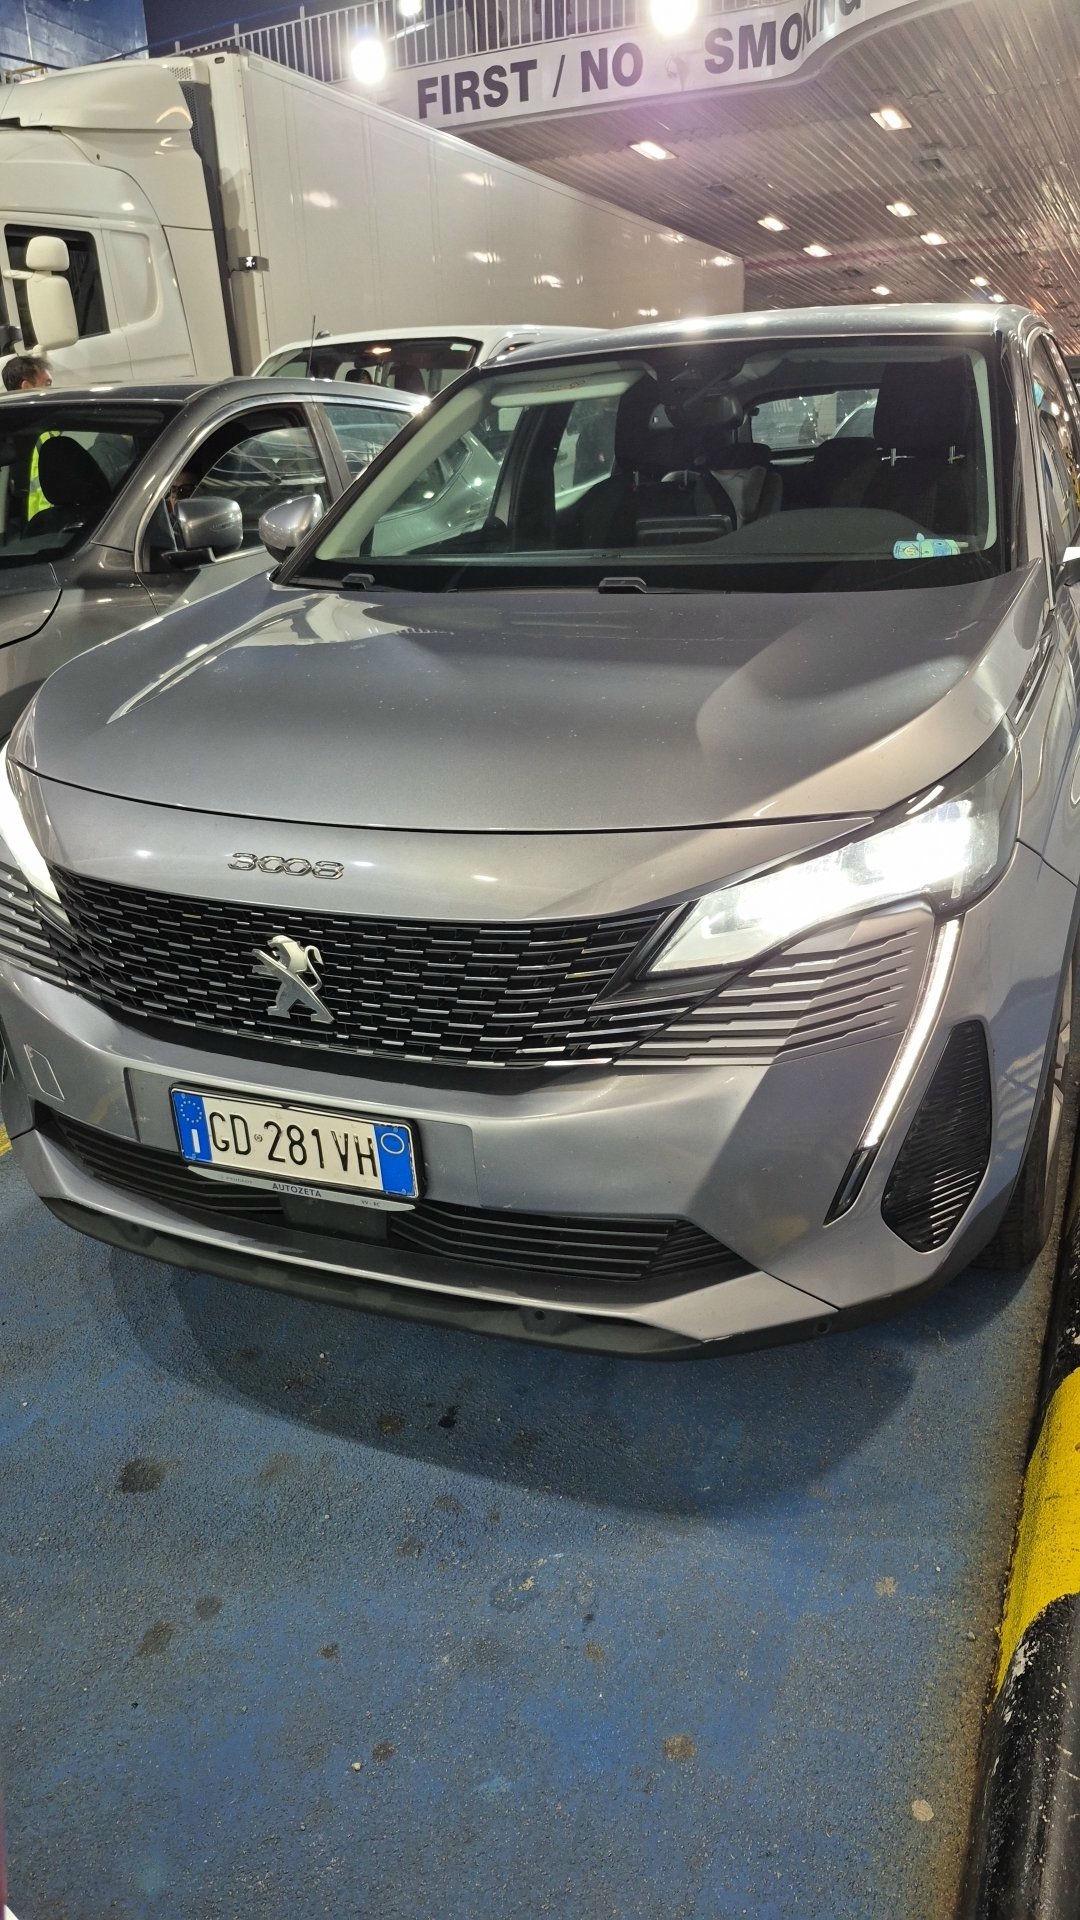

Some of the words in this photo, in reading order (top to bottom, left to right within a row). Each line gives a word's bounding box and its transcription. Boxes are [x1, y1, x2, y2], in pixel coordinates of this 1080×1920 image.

[417, 59, 538, 119] FIRST
[552, 54, 566, 98] /
[580, 42, 644, 93] NO
[227, 852, 345, 880] 3008
[209, 1111, 251, 1156] GD
[272, 1182, 322, 1198] AUTOZETA
